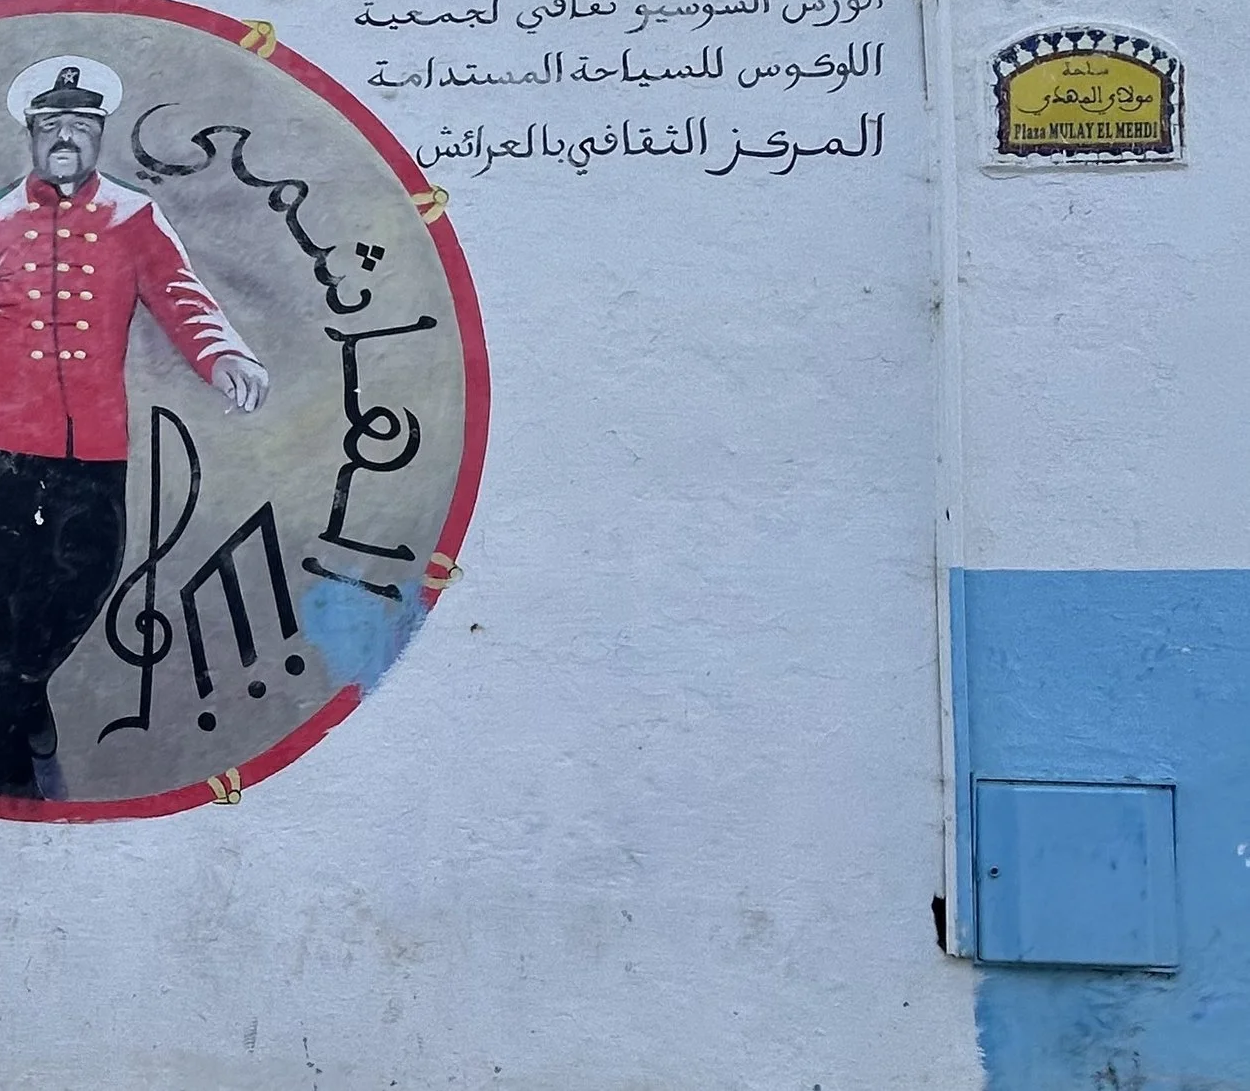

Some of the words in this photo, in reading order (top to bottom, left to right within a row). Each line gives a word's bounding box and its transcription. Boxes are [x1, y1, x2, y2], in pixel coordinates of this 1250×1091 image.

[366, 51, 564, 91] المستدامة
[569, 44, 724, 89] للسياحة
[737, 41, 886, 94] اللوكوس
[1061, 61, 1110, 77] ساحة
[1015, 84, 1103, 117] المهدي
[1079, 85, 1154, 115] مولاي
[704, 111, 886, 177] المركز
[1013, 122, 1047, 141] Plaza
[1049, 121, 1095, 140] MULAY
[1096, 121, 1114, 140] EL
[1115, 121, 1159, 139] MEHDI
